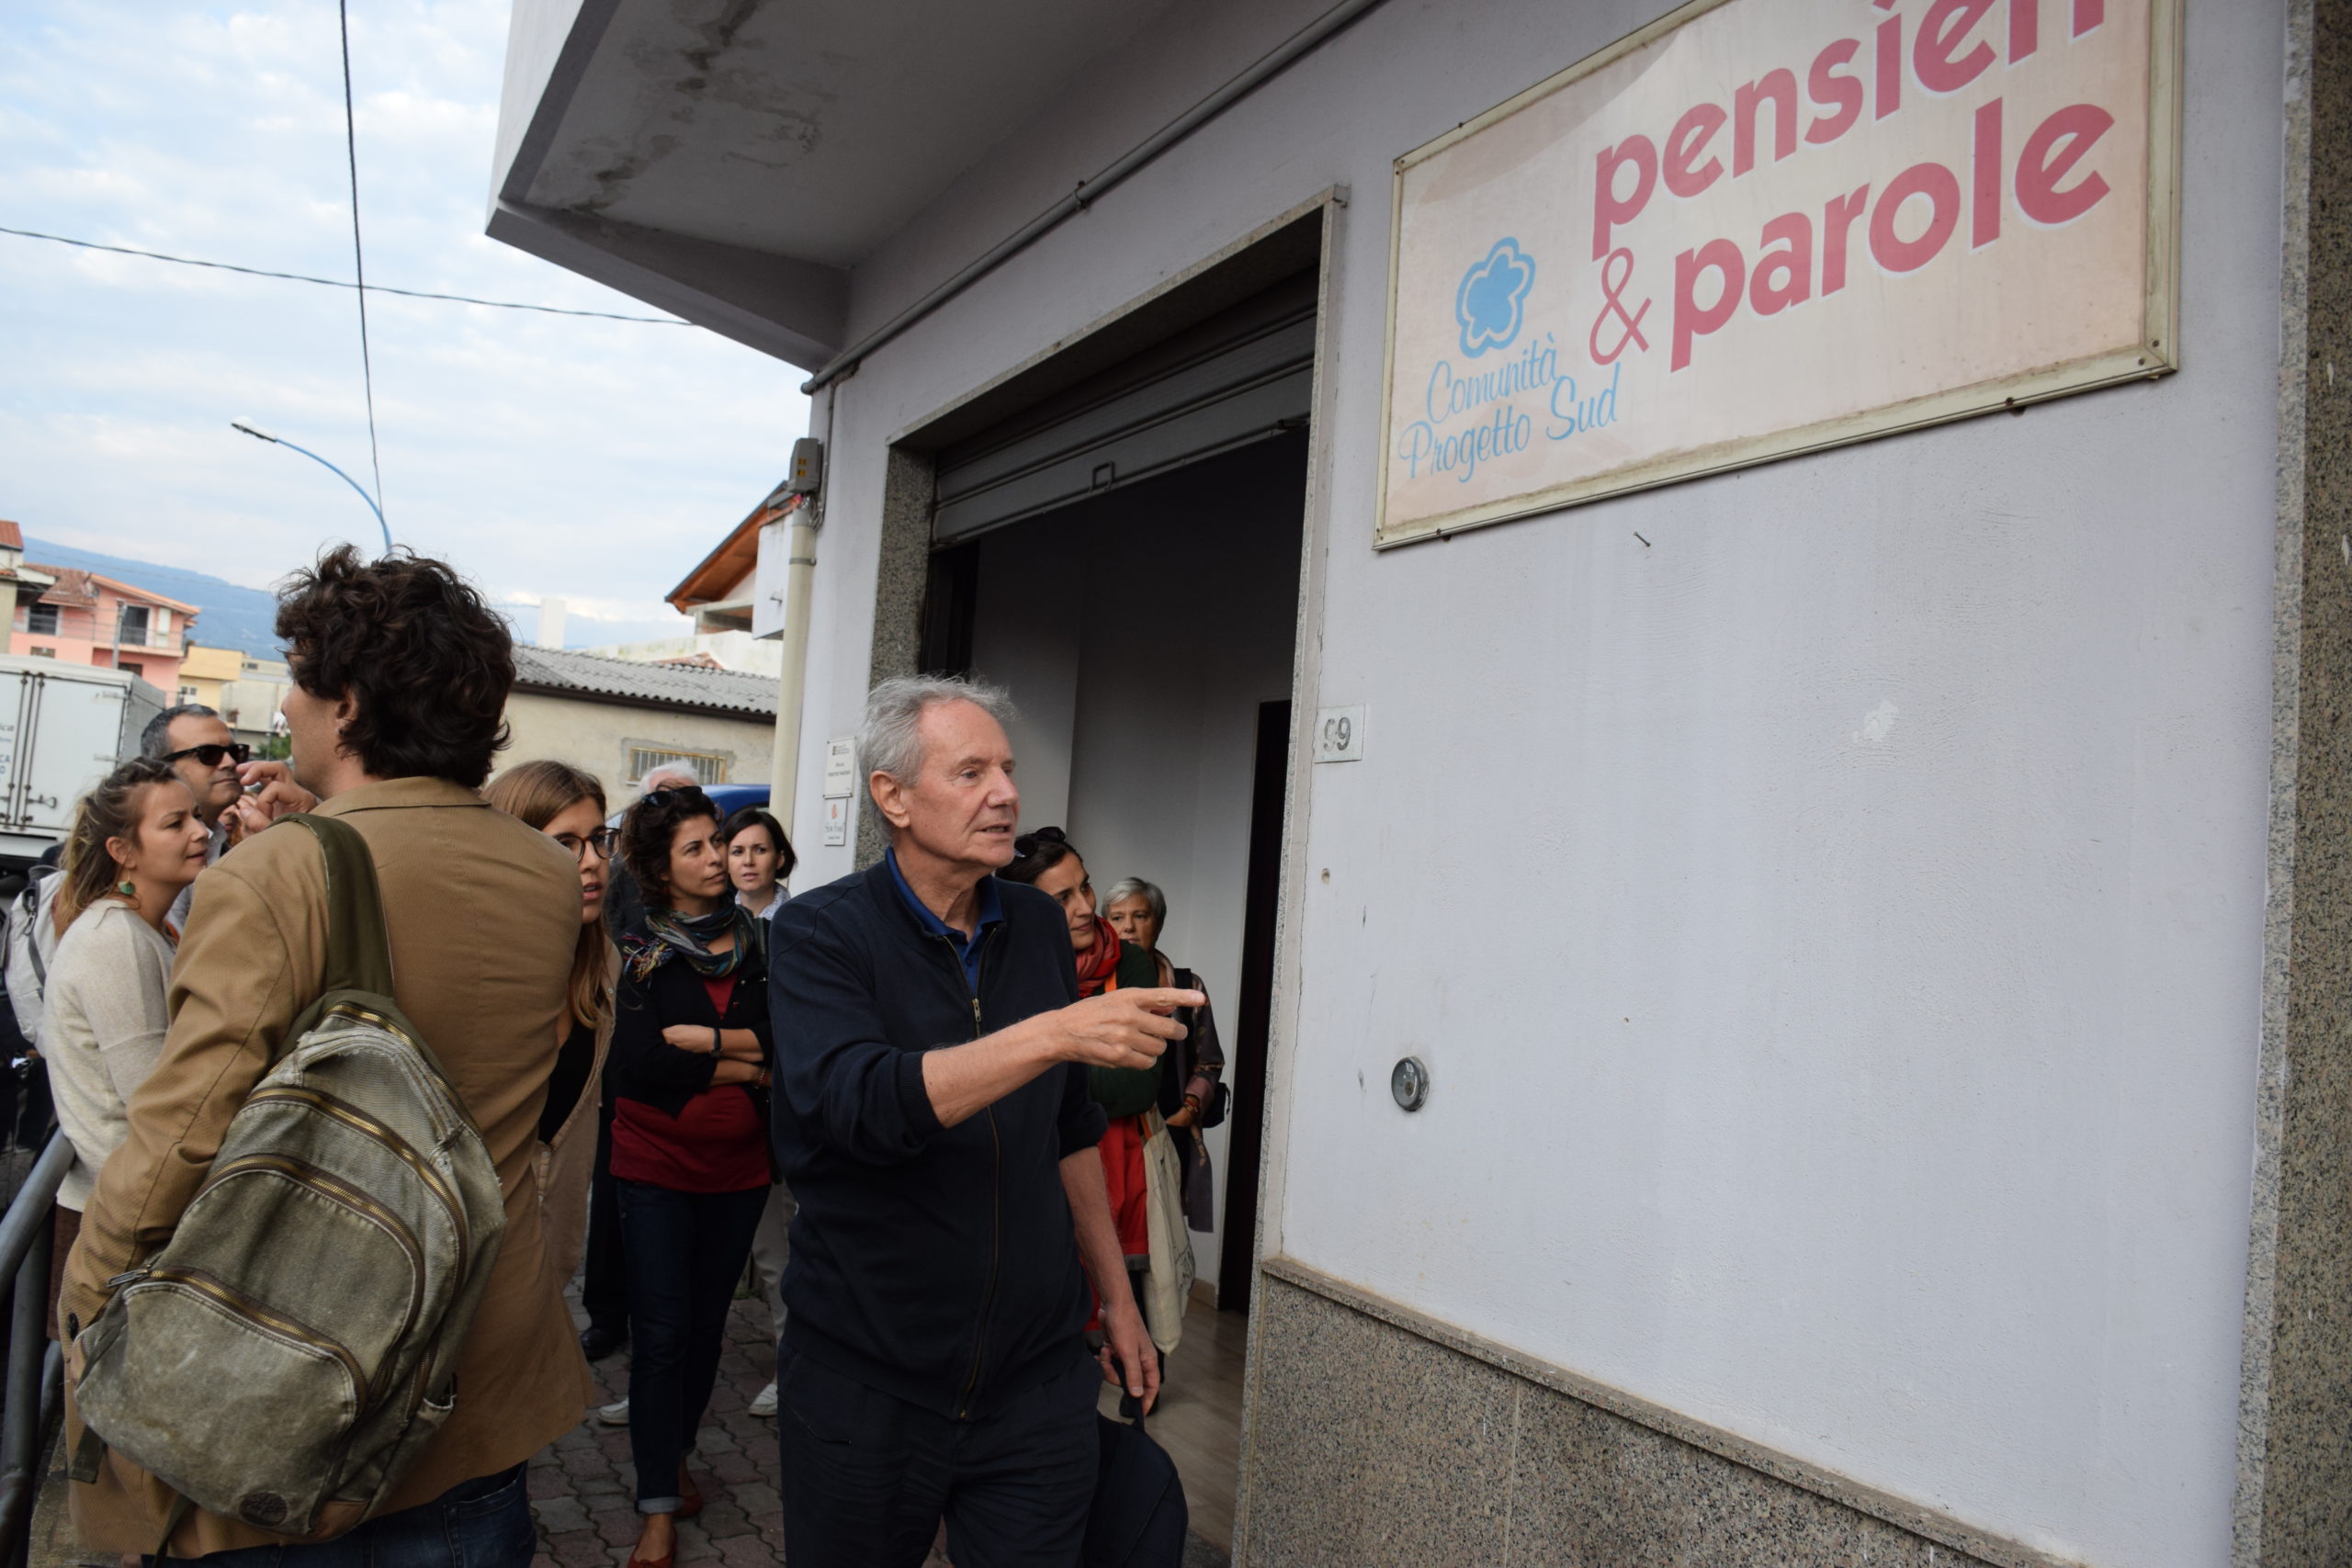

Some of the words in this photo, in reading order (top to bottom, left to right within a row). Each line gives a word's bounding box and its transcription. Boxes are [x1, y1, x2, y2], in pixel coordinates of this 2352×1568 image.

[1589, 247, 1651, 367] &
[1670, 98, 2115, 371] parole
[1397, 405, 1532, 484] Progetto
[1545, 361, 1623, 442] Sud
[1426, 332, 1557, 424] Comunità
